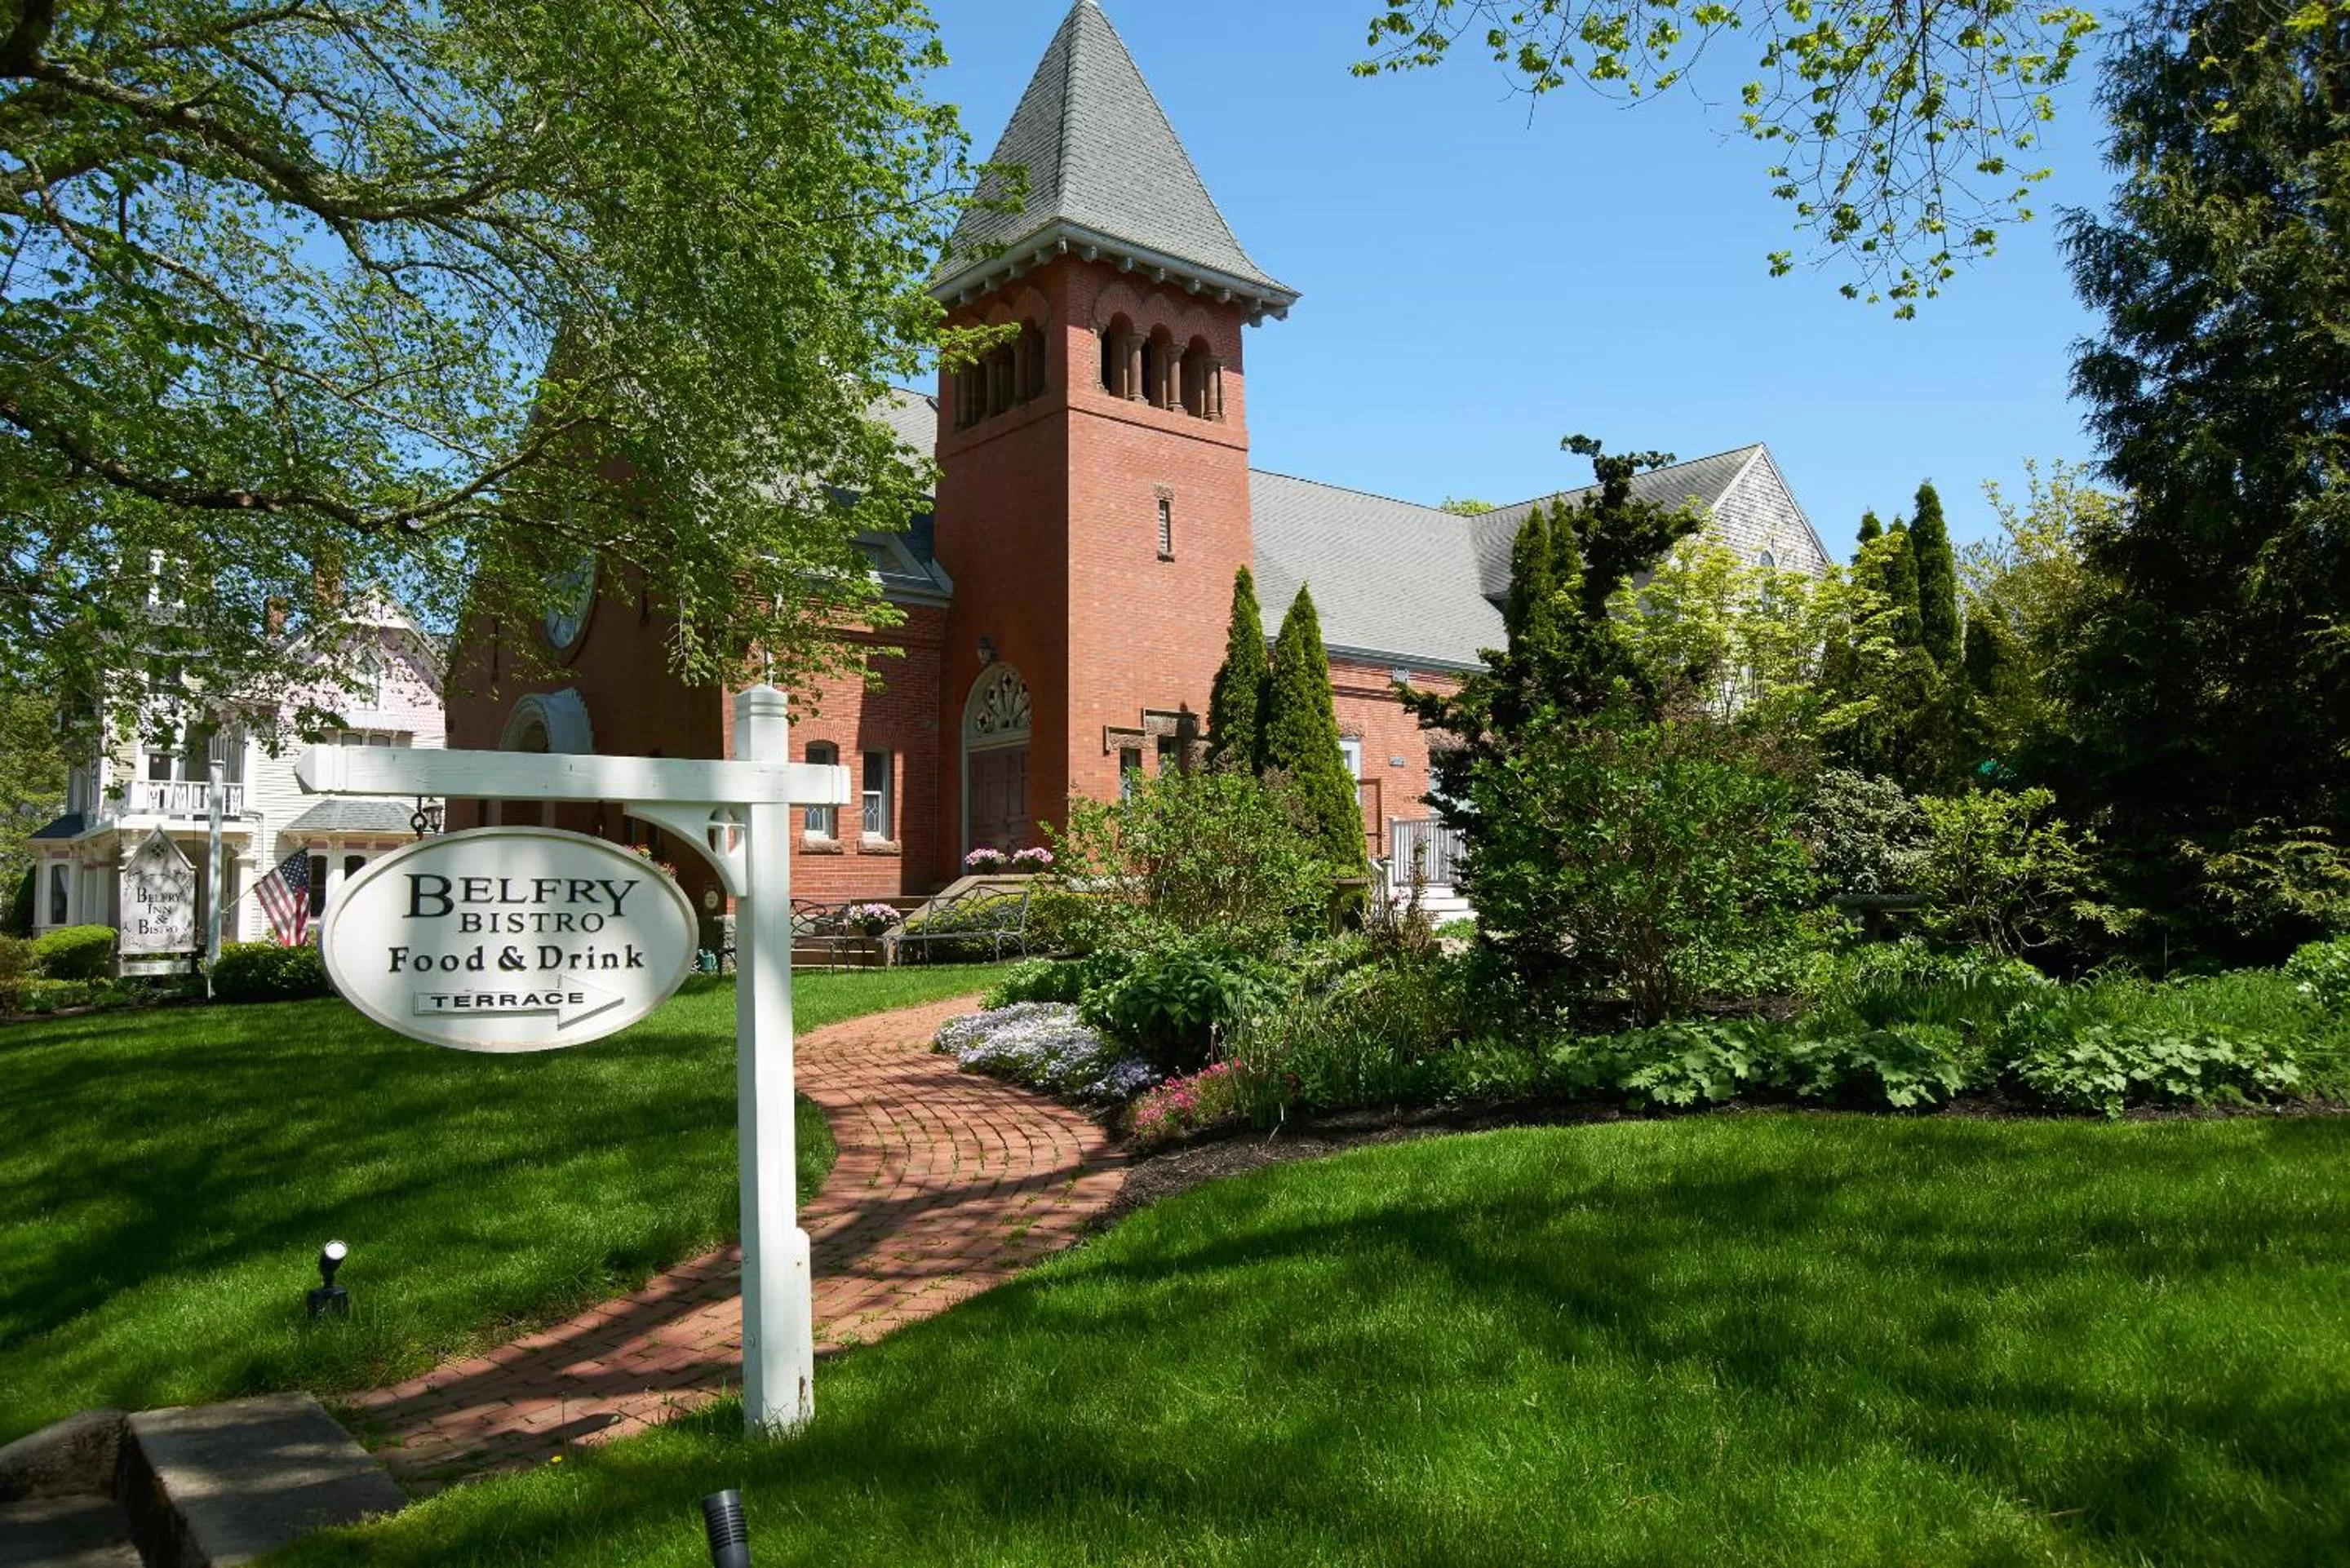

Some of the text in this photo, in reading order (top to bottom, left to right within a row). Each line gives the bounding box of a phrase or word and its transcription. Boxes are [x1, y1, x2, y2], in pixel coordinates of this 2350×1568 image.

[403, 873, 640, 919] BELFRY
[459, 912, 605, 933] BISTRO
[388, 945, 645, 972] Food & Drink
[431, 992, 585, 1008] TERRACE
